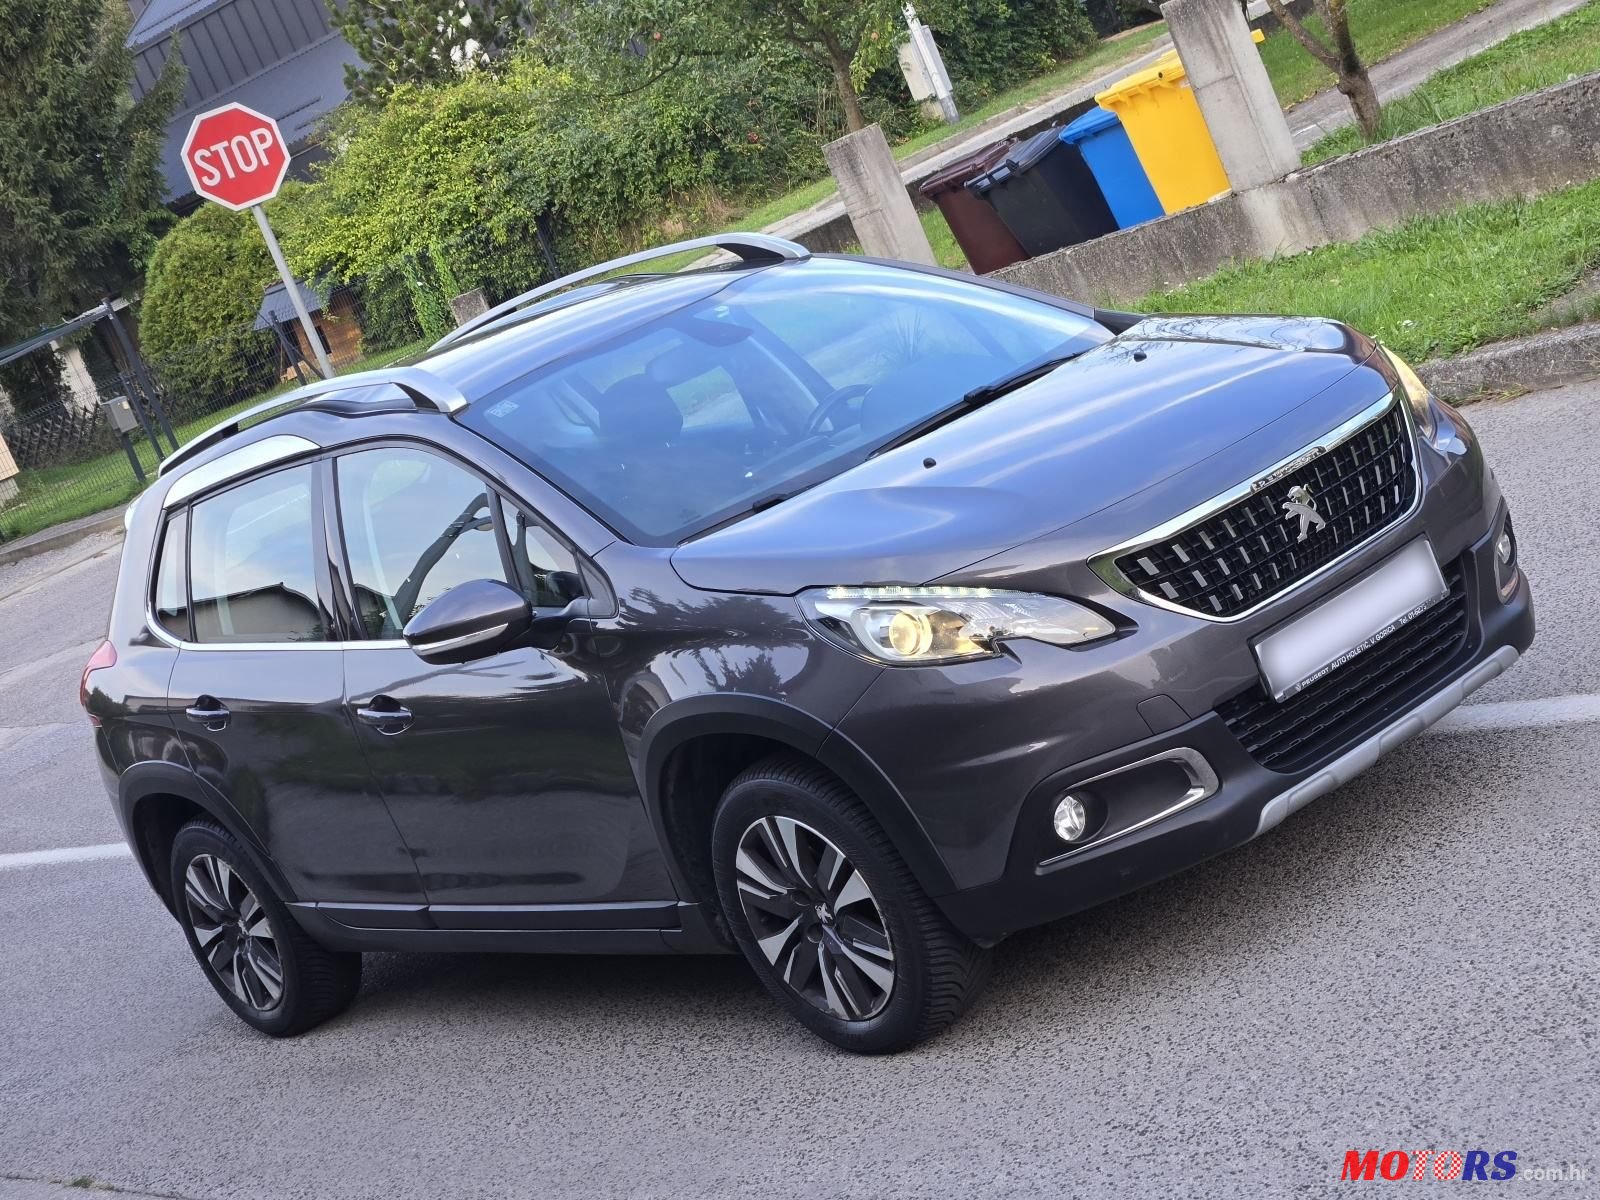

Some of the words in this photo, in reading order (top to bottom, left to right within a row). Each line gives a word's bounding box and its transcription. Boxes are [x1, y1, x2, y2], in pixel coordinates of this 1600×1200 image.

[194, 127, 273, 187] STOP
[1331, 655, 1347, 670] AUTO
[1375, 624, 1396, 641] GORICA
